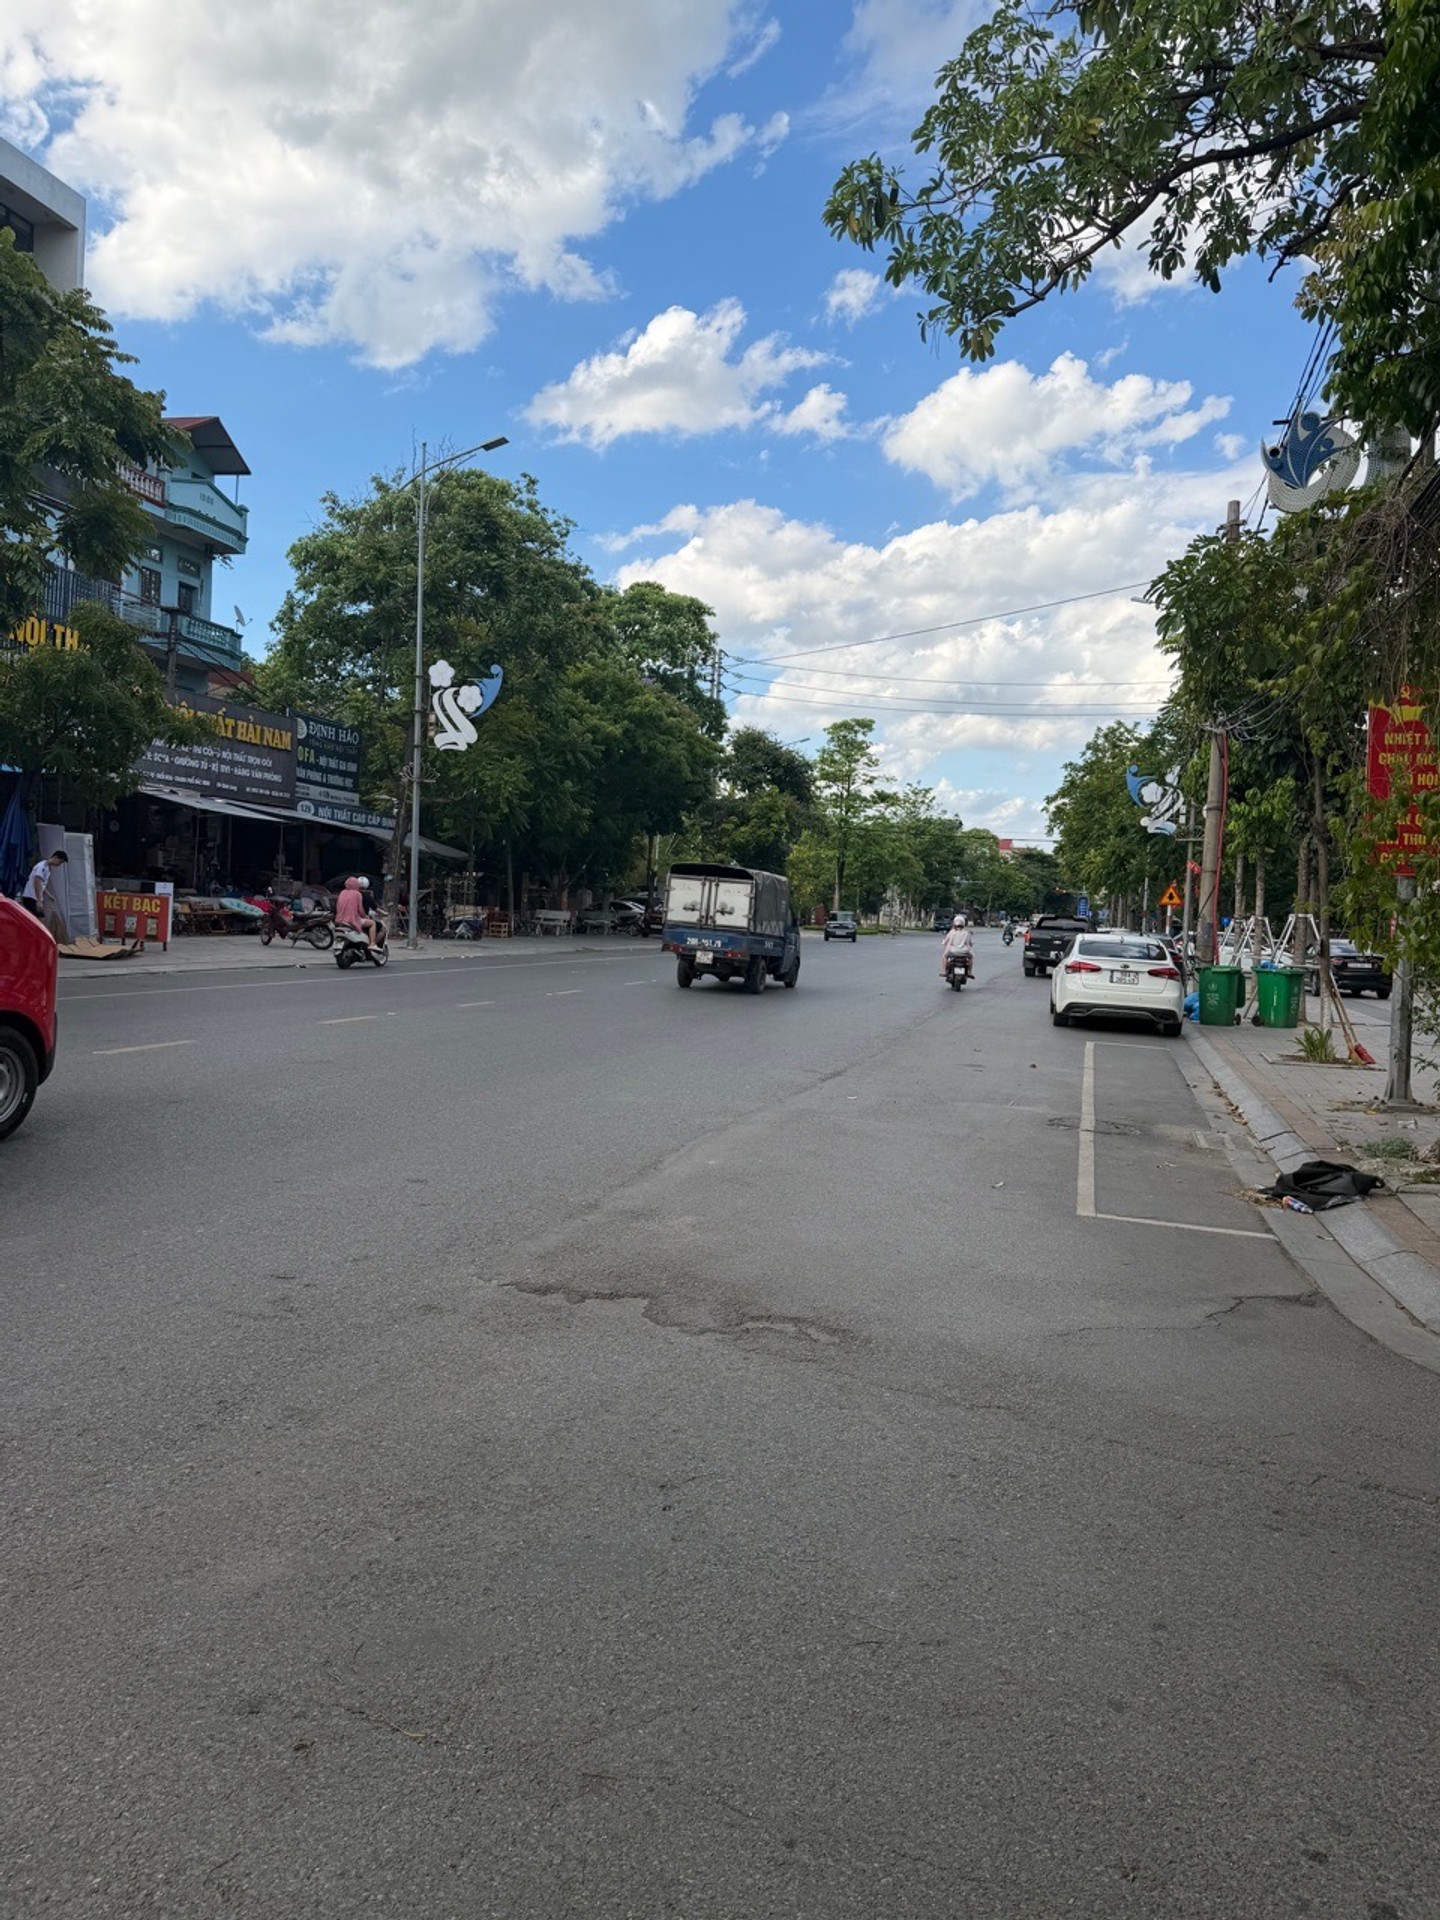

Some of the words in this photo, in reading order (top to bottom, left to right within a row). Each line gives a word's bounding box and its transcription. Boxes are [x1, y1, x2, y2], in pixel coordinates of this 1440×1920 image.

[236, 715, 261, 746] HẢI
[263, 726, 292, 752] NAM
[309, 721, 336, 740] ĐỊNH
[1417, 772, 1438, 788] HỘI
[132, 897, 160, 915] BẠC
